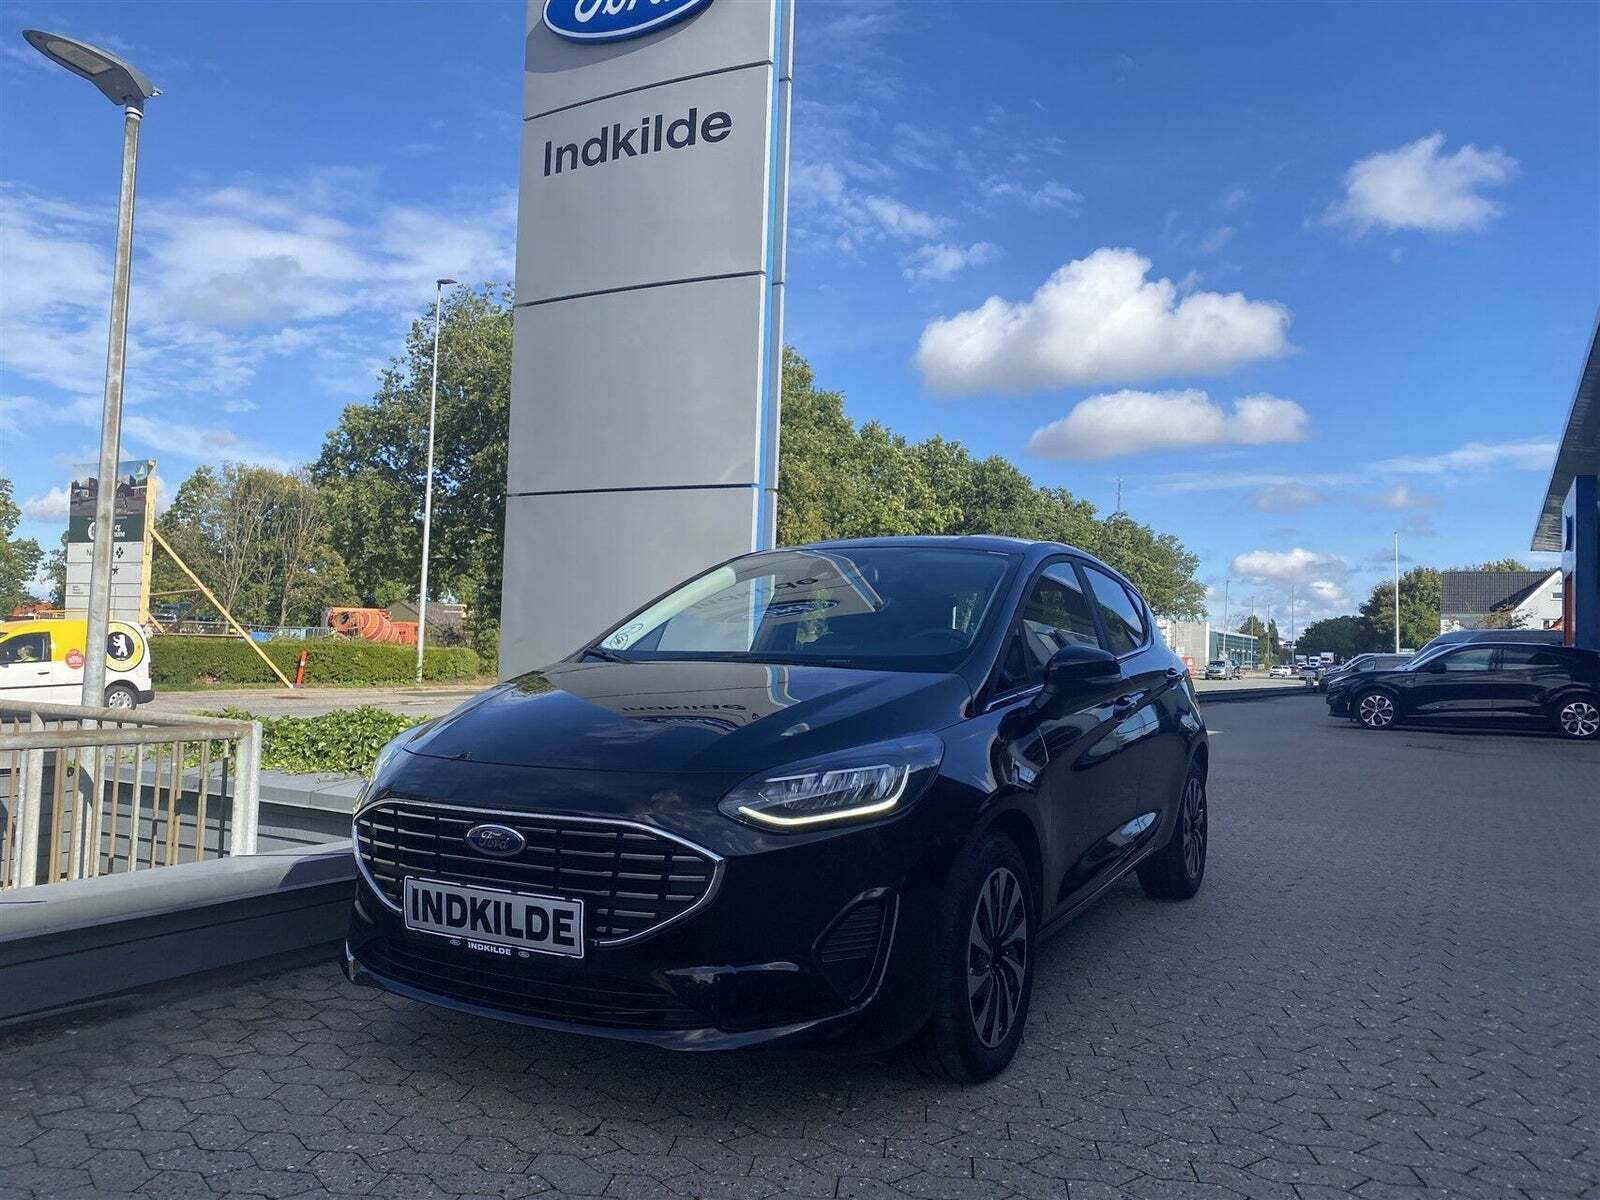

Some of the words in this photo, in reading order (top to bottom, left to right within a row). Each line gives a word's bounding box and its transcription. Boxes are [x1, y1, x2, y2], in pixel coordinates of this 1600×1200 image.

[543, 108, 733, 177] Indkilde
[411, 885, 575, 947] INDKILDE
[468, 942, 512, 956] INDKILDE
